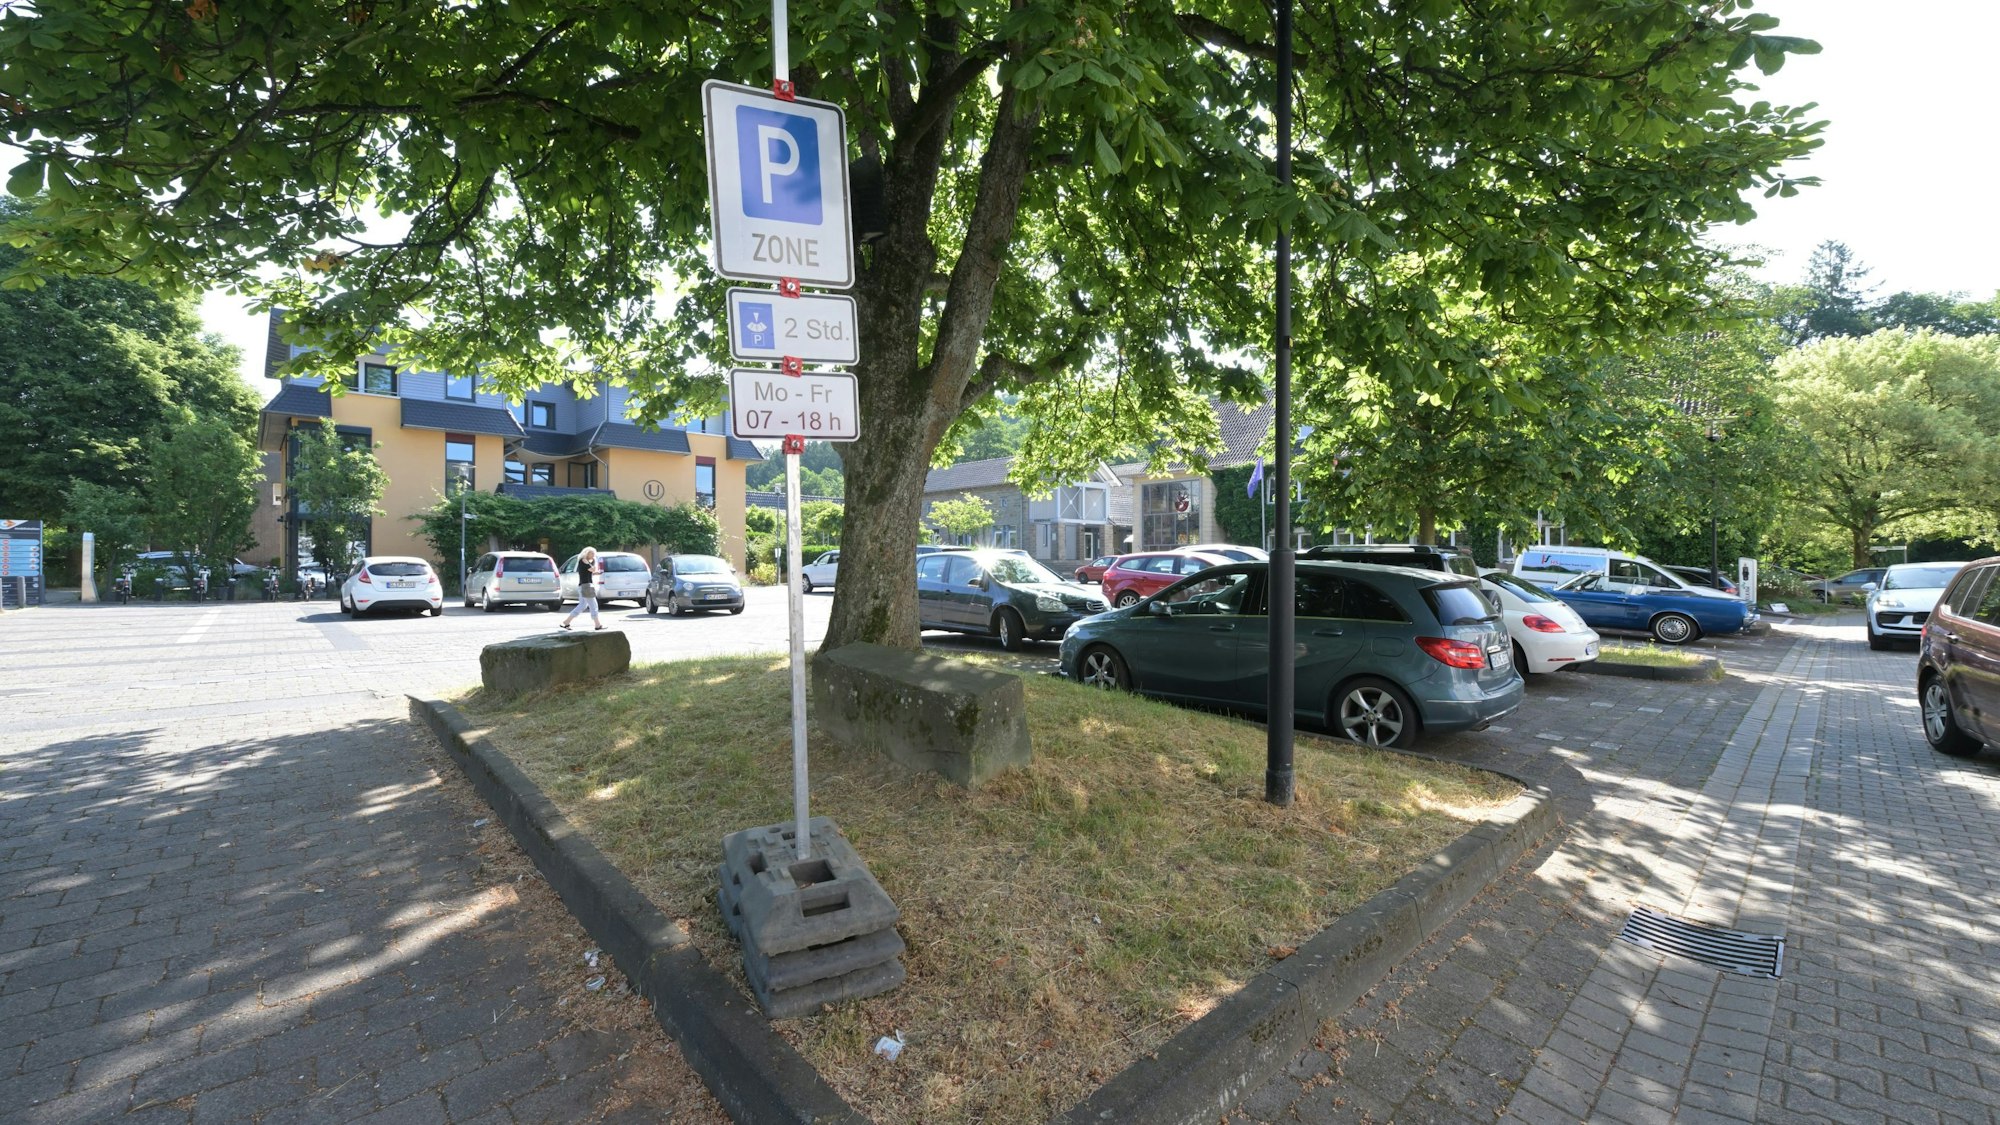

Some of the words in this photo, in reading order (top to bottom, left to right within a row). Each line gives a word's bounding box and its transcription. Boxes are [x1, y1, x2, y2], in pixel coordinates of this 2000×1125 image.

[758, 124, 800, 205] P
[751, 232, 820, 268] ZONE
[754, 334, 762, 345] P
[784, 317, 798, 339] 2
[806, 318, 850, 341] Std.
[754, 381, 788, 402] Mo
[810, 384, 833, 404] Fr
[746, 409, 773, 430] 07
[797, 411, 822, 431] 18
[829, 411, 841, 431] h
[648, 484, 660, 497] U
